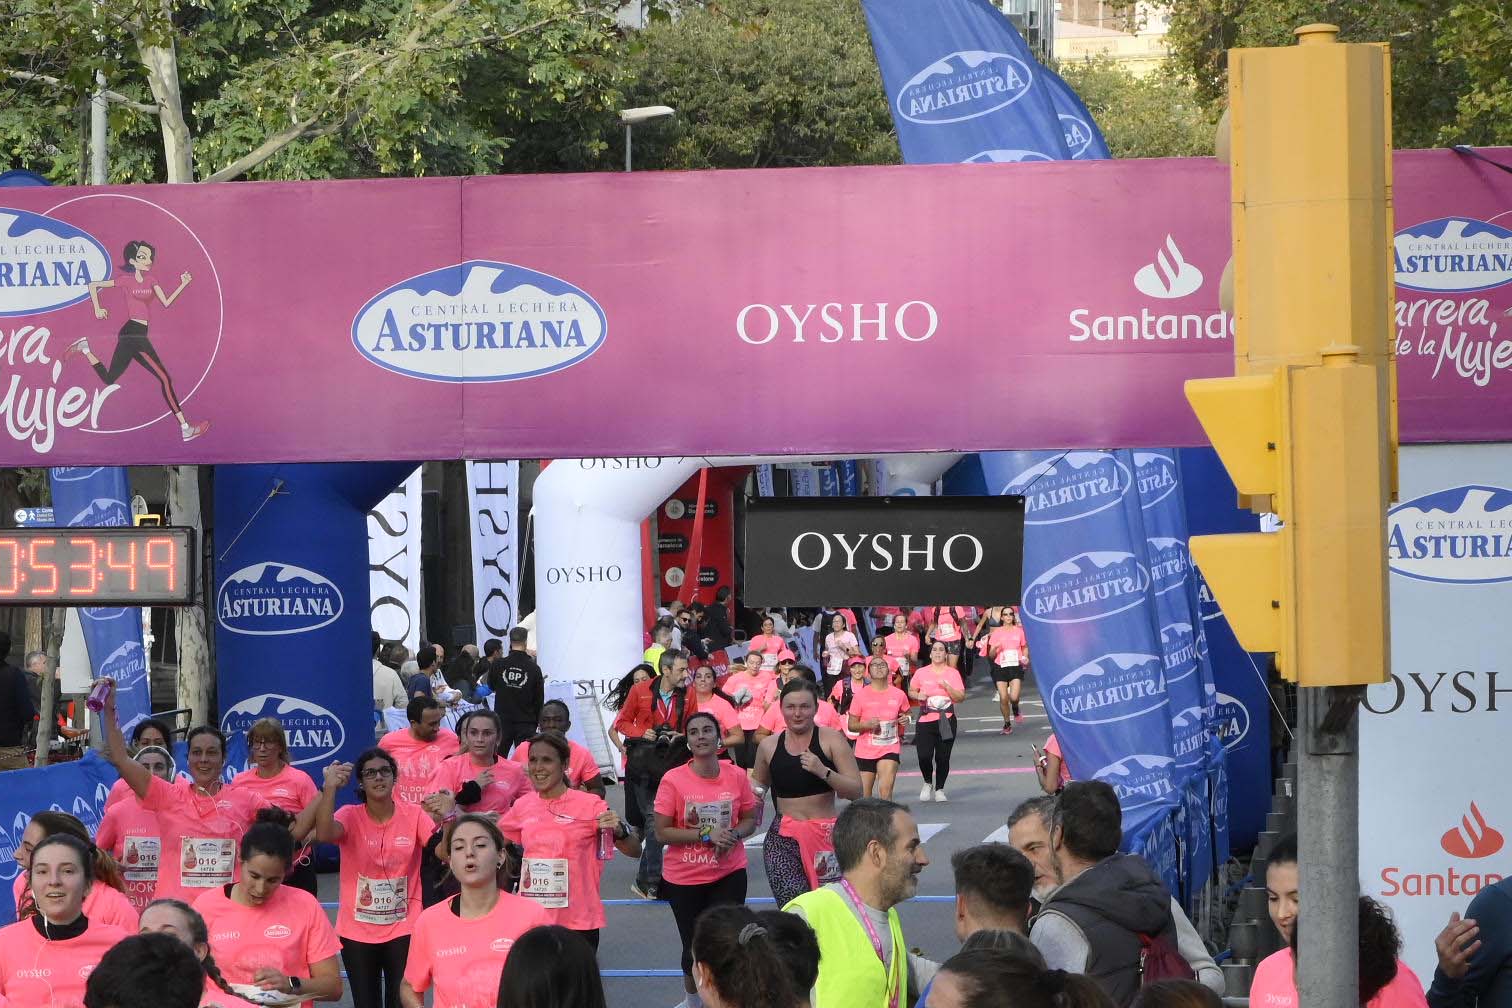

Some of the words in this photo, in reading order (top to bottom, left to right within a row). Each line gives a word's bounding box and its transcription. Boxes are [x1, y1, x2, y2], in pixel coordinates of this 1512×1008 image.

[14, 244, 87, 256] LECHERA
[410, 303, 491, 318] CENTRAL
[498, 301, 580, 315] LECHERA
[1394, 298, 1490, 328] arrera
[371, 307, 587, 354] ASTURIANA
[735, 300, 939, 346] OYSHO
[1068, 308, 1235, 342] Santand
[1418, 327, 1436, 356] la
[1431, 322, 1512, 388] Muje
[1415, 519, 1482, 531] CENTRAL
[790, 531, 984, 574] OYSHO
[546, 564, 622, 585] OYSHO
[234, 587, 276, 596] CENTRAL
[281, 586, 330, 595] LECHERA
[221, 591, 334, 619] ASTURIANA
[281, 718, 330, 727] LECHERA
[198, 857, 217, 866] 016
[532, 877, 549, 886] 016
[374, 896, 392, 905] 016
[16, 967, 52, 979] OYSHO
